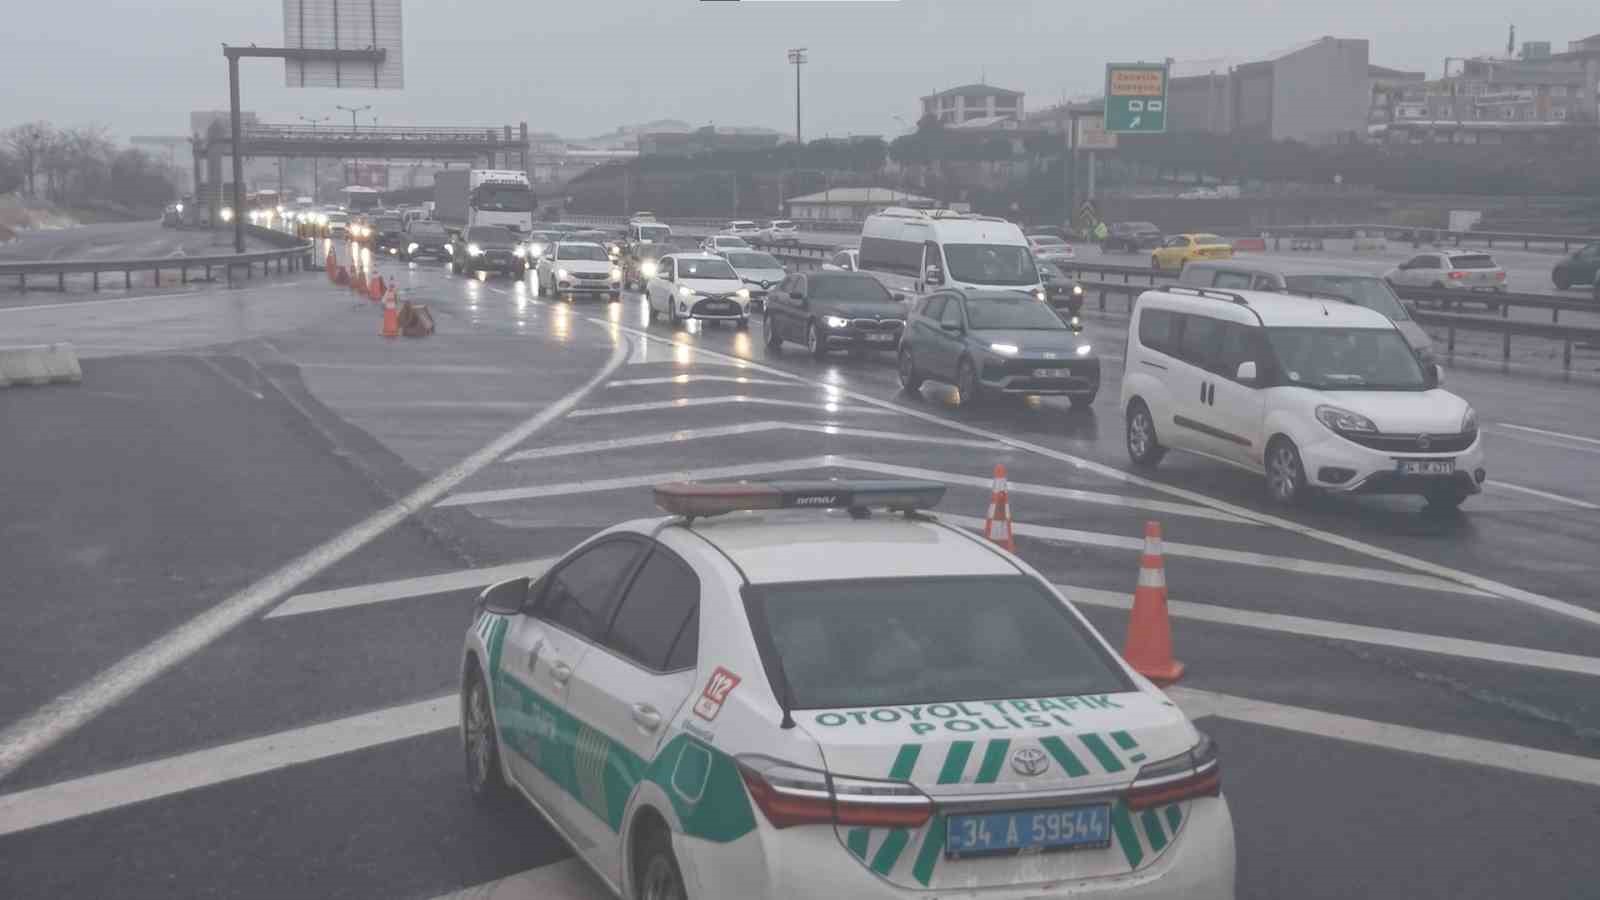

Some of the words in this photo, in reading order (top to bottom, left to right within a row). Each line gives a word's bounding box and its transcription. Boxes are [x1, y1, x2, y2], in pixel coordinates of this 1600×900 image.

[707, 672, 733, 700] 112
[815, 702, 982, 726] OTOYOL
[962, 819, 992, 848] 34
[1006, 814, 1019, 846] A
[1032, 810, 1103, 841] 59544
